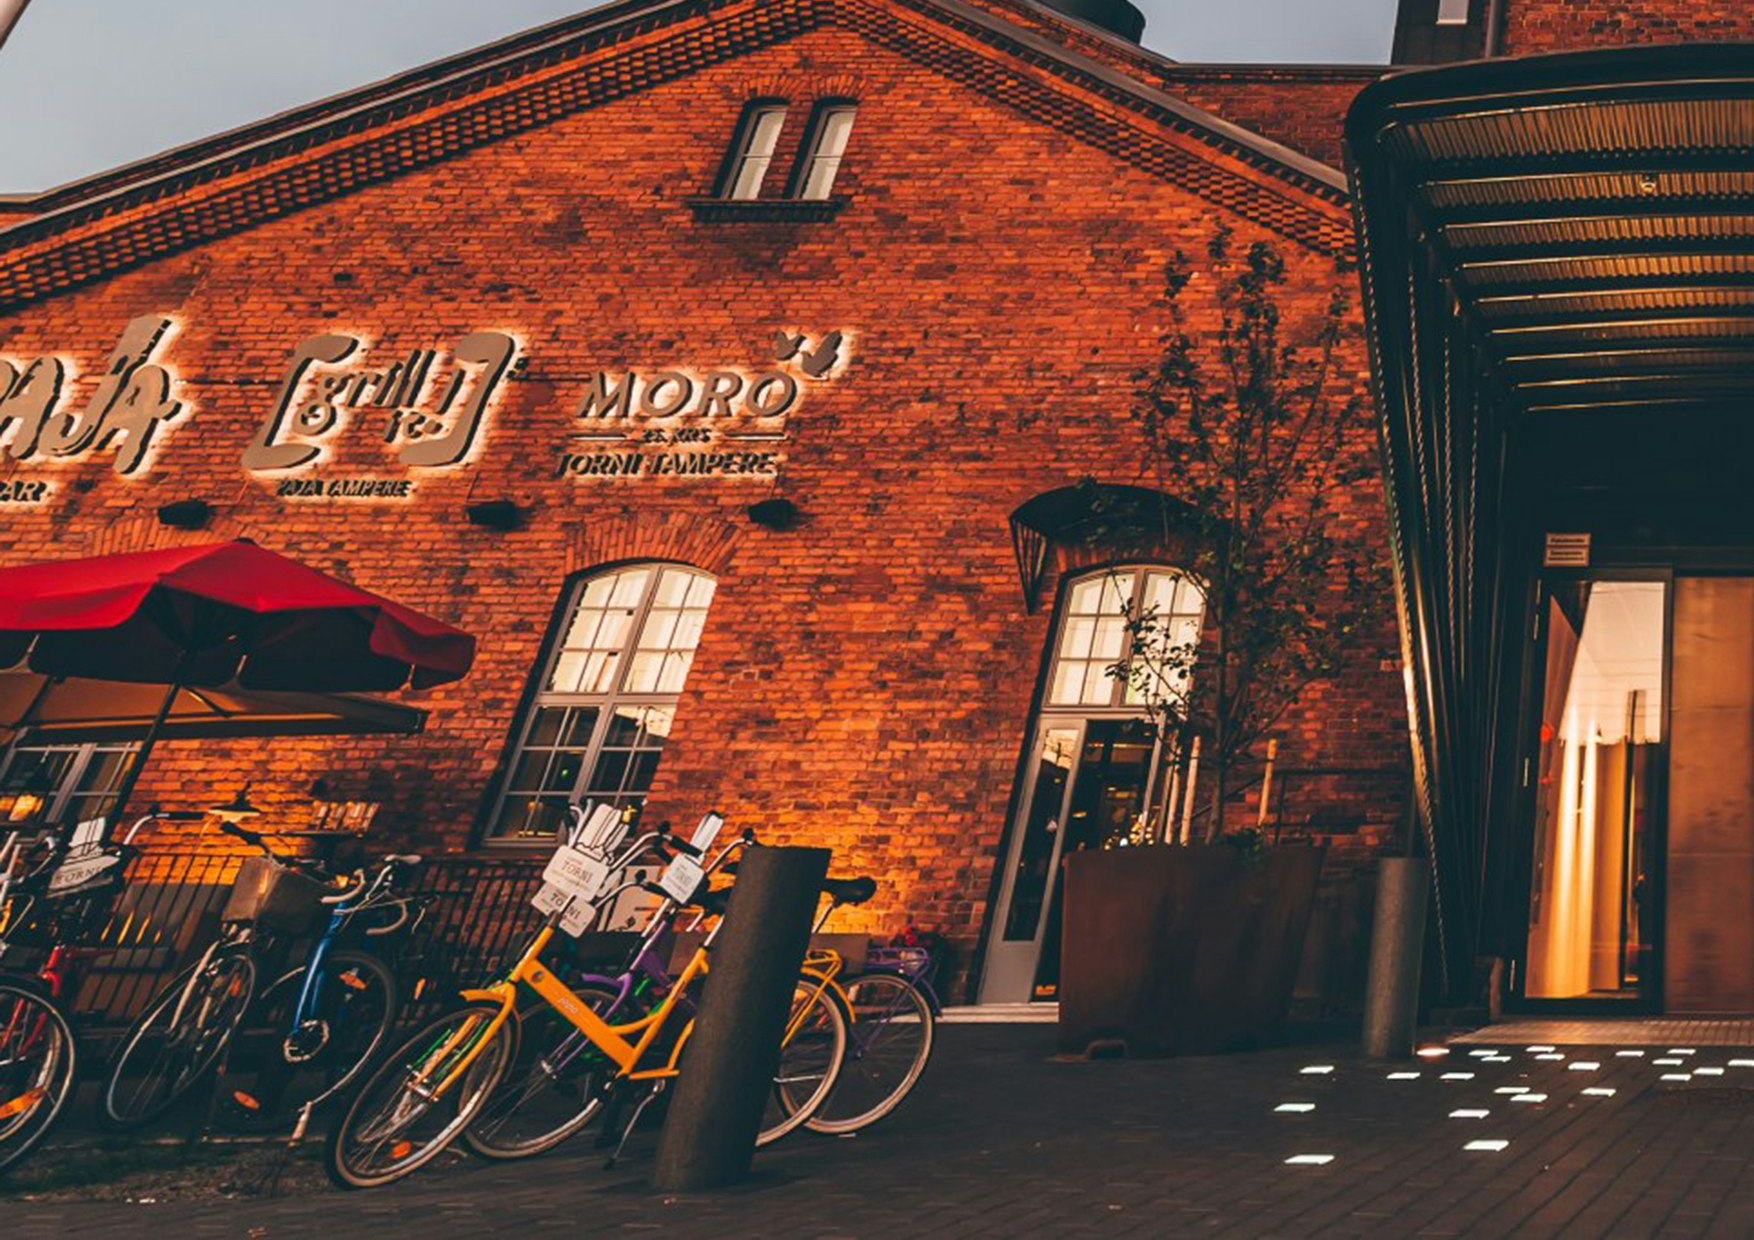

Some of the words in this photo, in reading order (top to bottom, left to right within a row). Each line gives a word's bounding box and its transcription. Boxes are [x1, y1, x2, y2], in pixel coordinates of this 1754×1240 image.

[576, 369, 798, 418] MORO
[556, 451, 641, 476] TORNI
[645, 450, 778, 475] TAMPERE
[327, 478, 412, 498] TAMPERE
[551, 892, 582, 920] TONI
